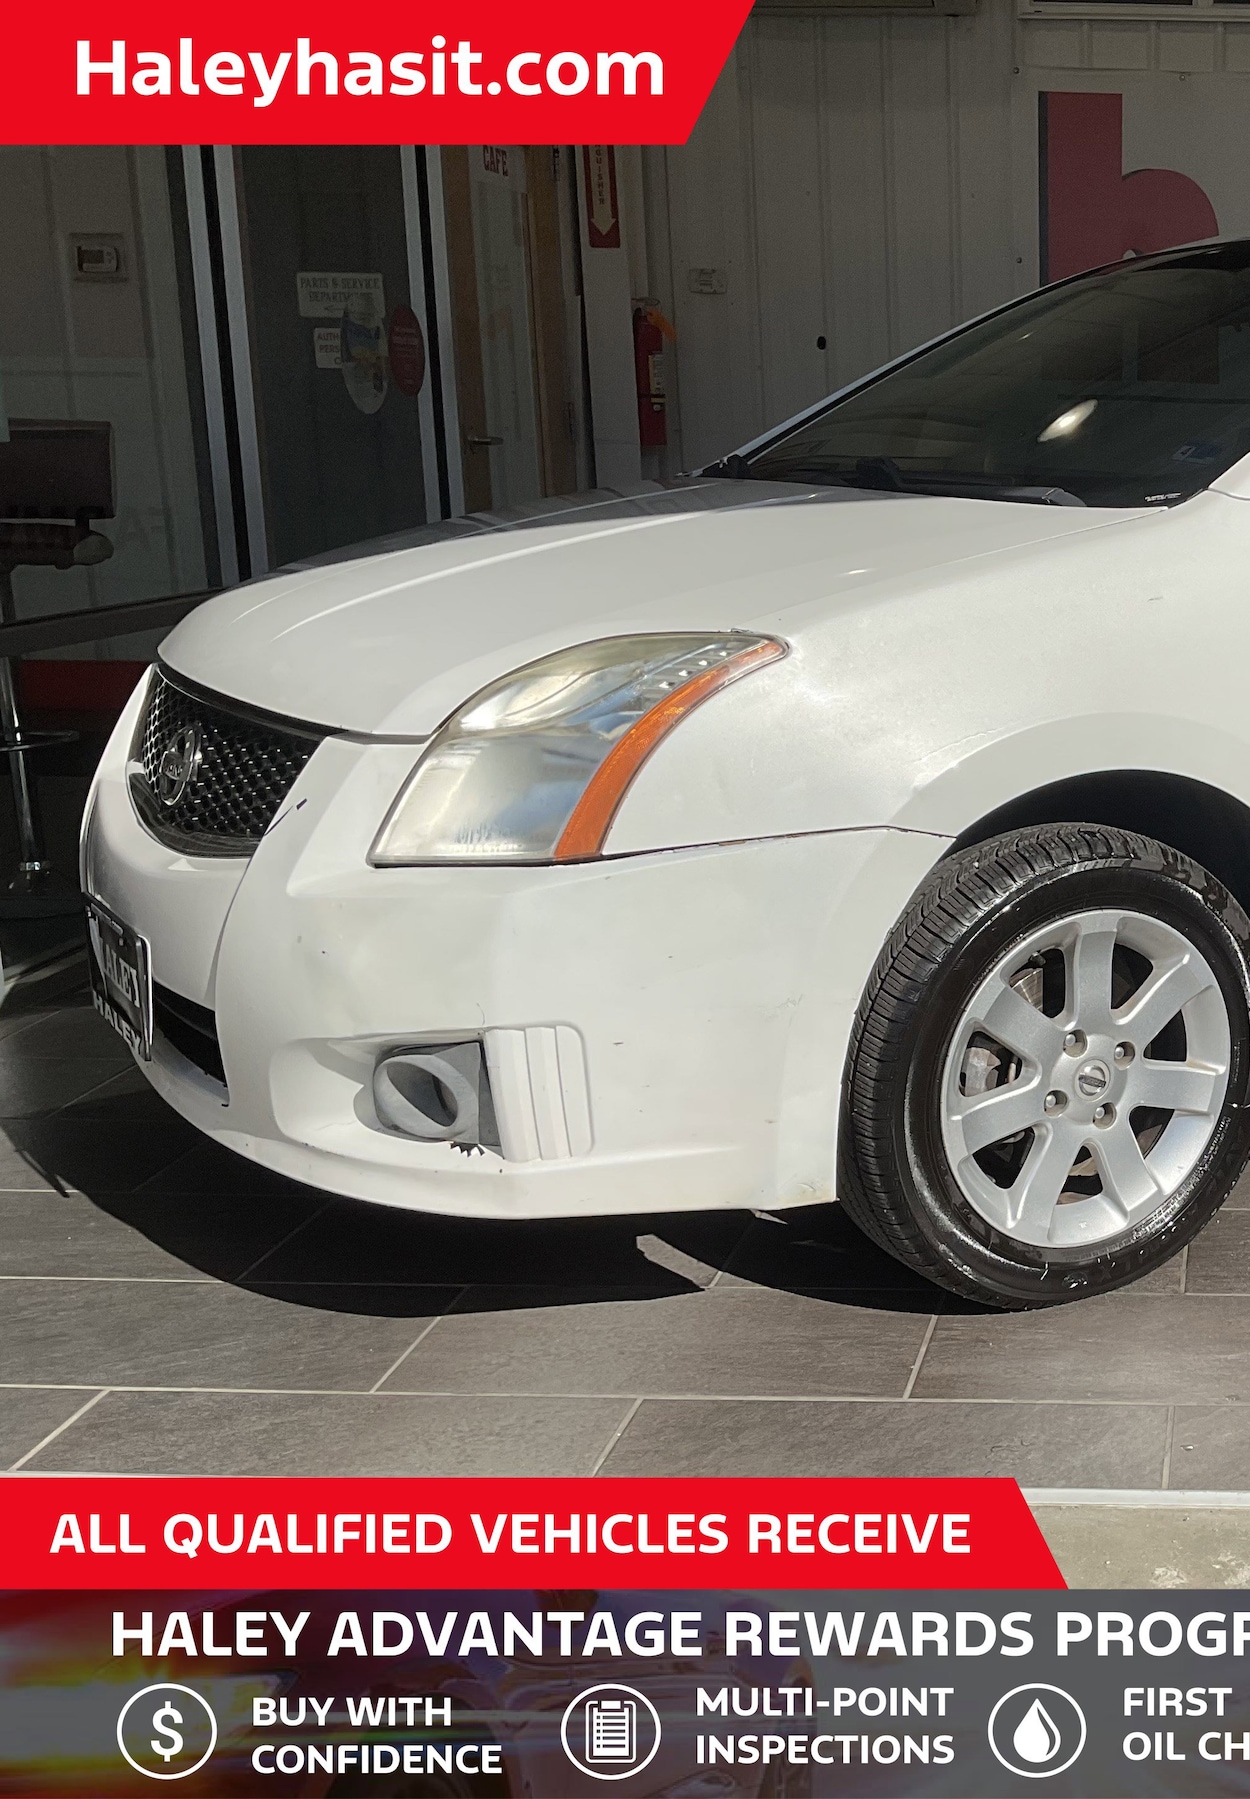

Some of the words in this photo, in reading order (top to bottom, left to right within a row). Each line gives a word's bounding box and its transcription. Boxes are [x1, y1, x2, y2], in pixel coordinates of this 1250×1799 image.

[300, 277, 329, 289] PARTS
[341, 277, 380, 290] SERVICE
[92, 988, 142, 1055] HALEY
